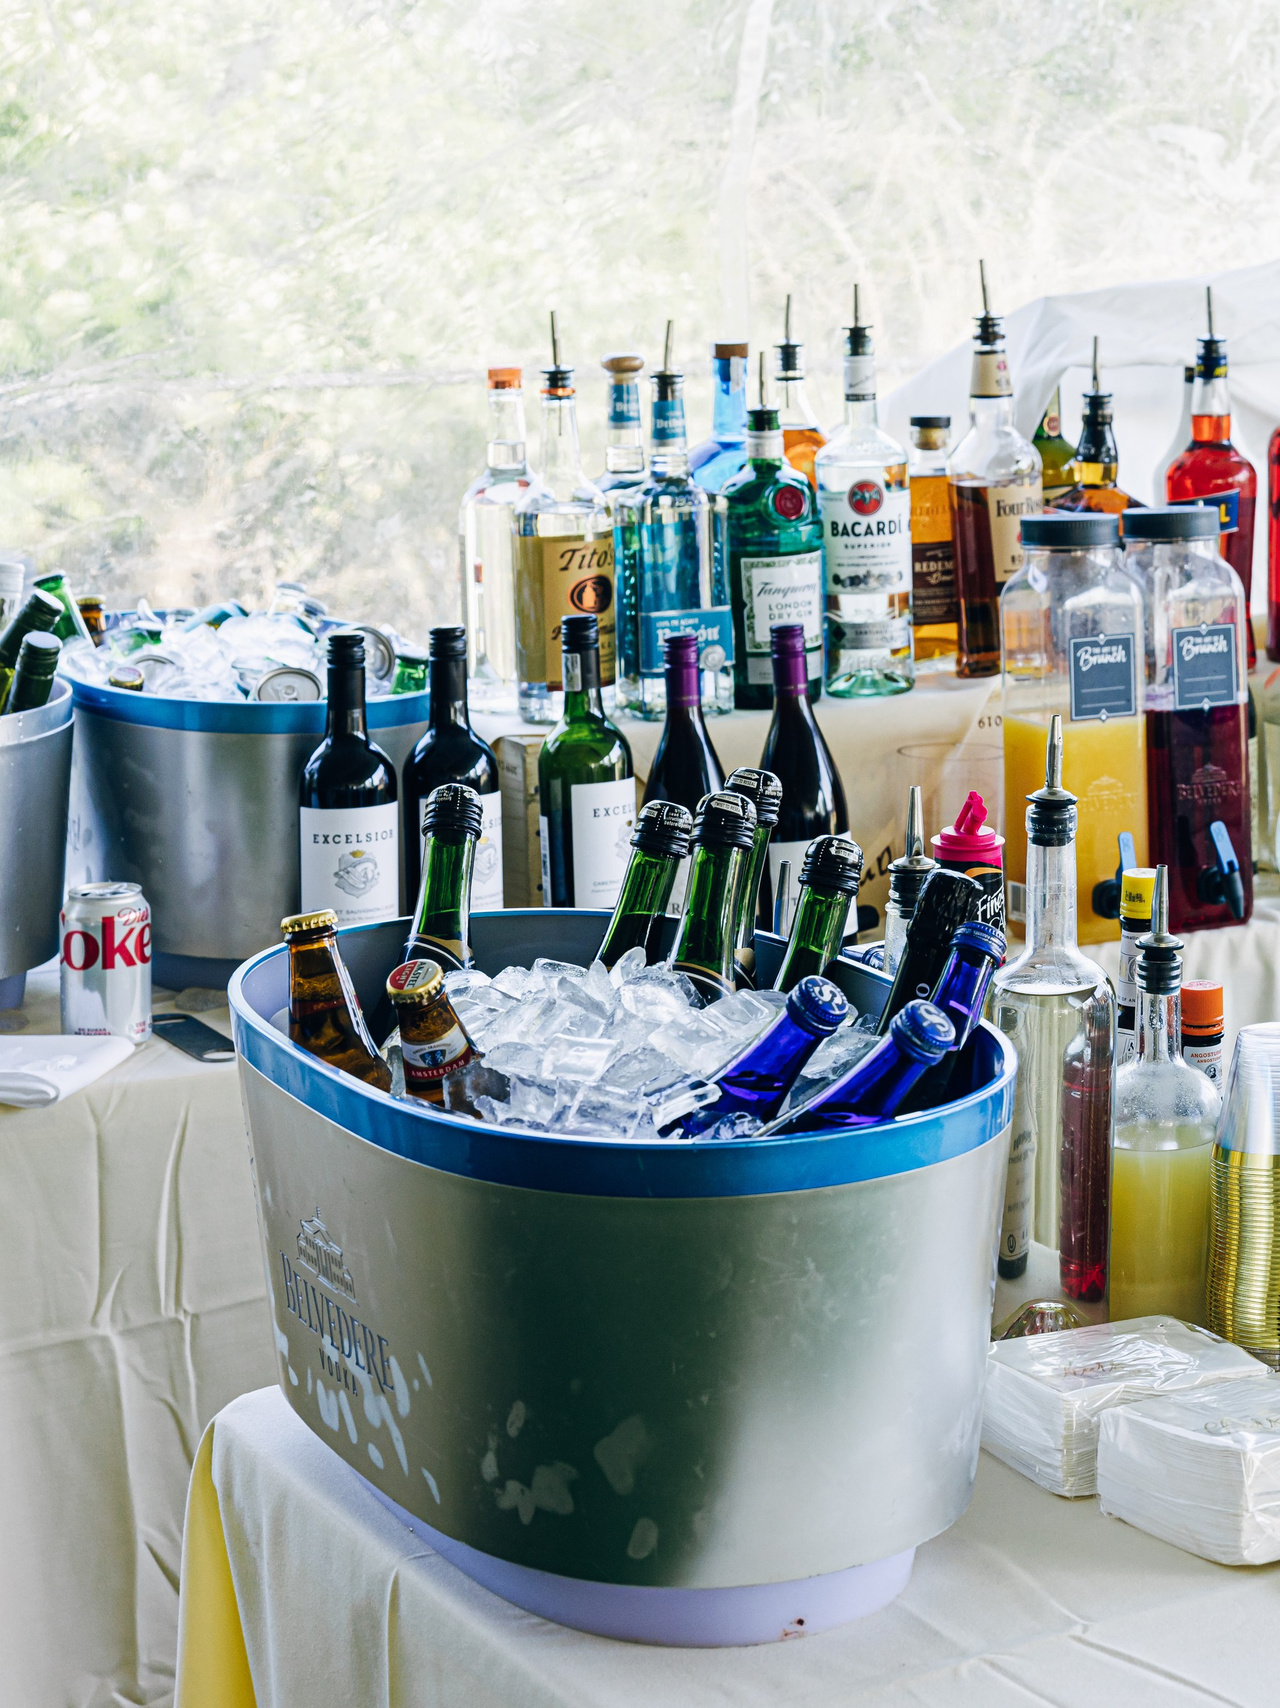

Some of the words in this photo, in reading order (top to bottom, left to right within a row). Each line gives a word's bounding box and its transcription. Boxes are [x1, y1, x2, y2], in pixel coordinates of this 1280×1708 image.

[996, 500, 1024, 517] Four
[768, 600, 813, 611] LONDON
[768, 612, 792, 621] DRY
[796, 609, 813, 618] GIN
[656, 624, 720, 647] Bibón
[1076, 644, 1127, 672] Brunch
[1179, 634, 1228, 662] Brunch
[313, 829, 394, 845] EXCELSIOR
[117, 906, 149, 926] Diet
[59, 909, 151, 971] oke
[397, 963, 414, 985] LIGHT
[411, 1059, 466, 1078] AMSTERDAM
[280, 1249, 395, 1394] BELVEDERE
[318, 1347, 359, 1397] VODKA
